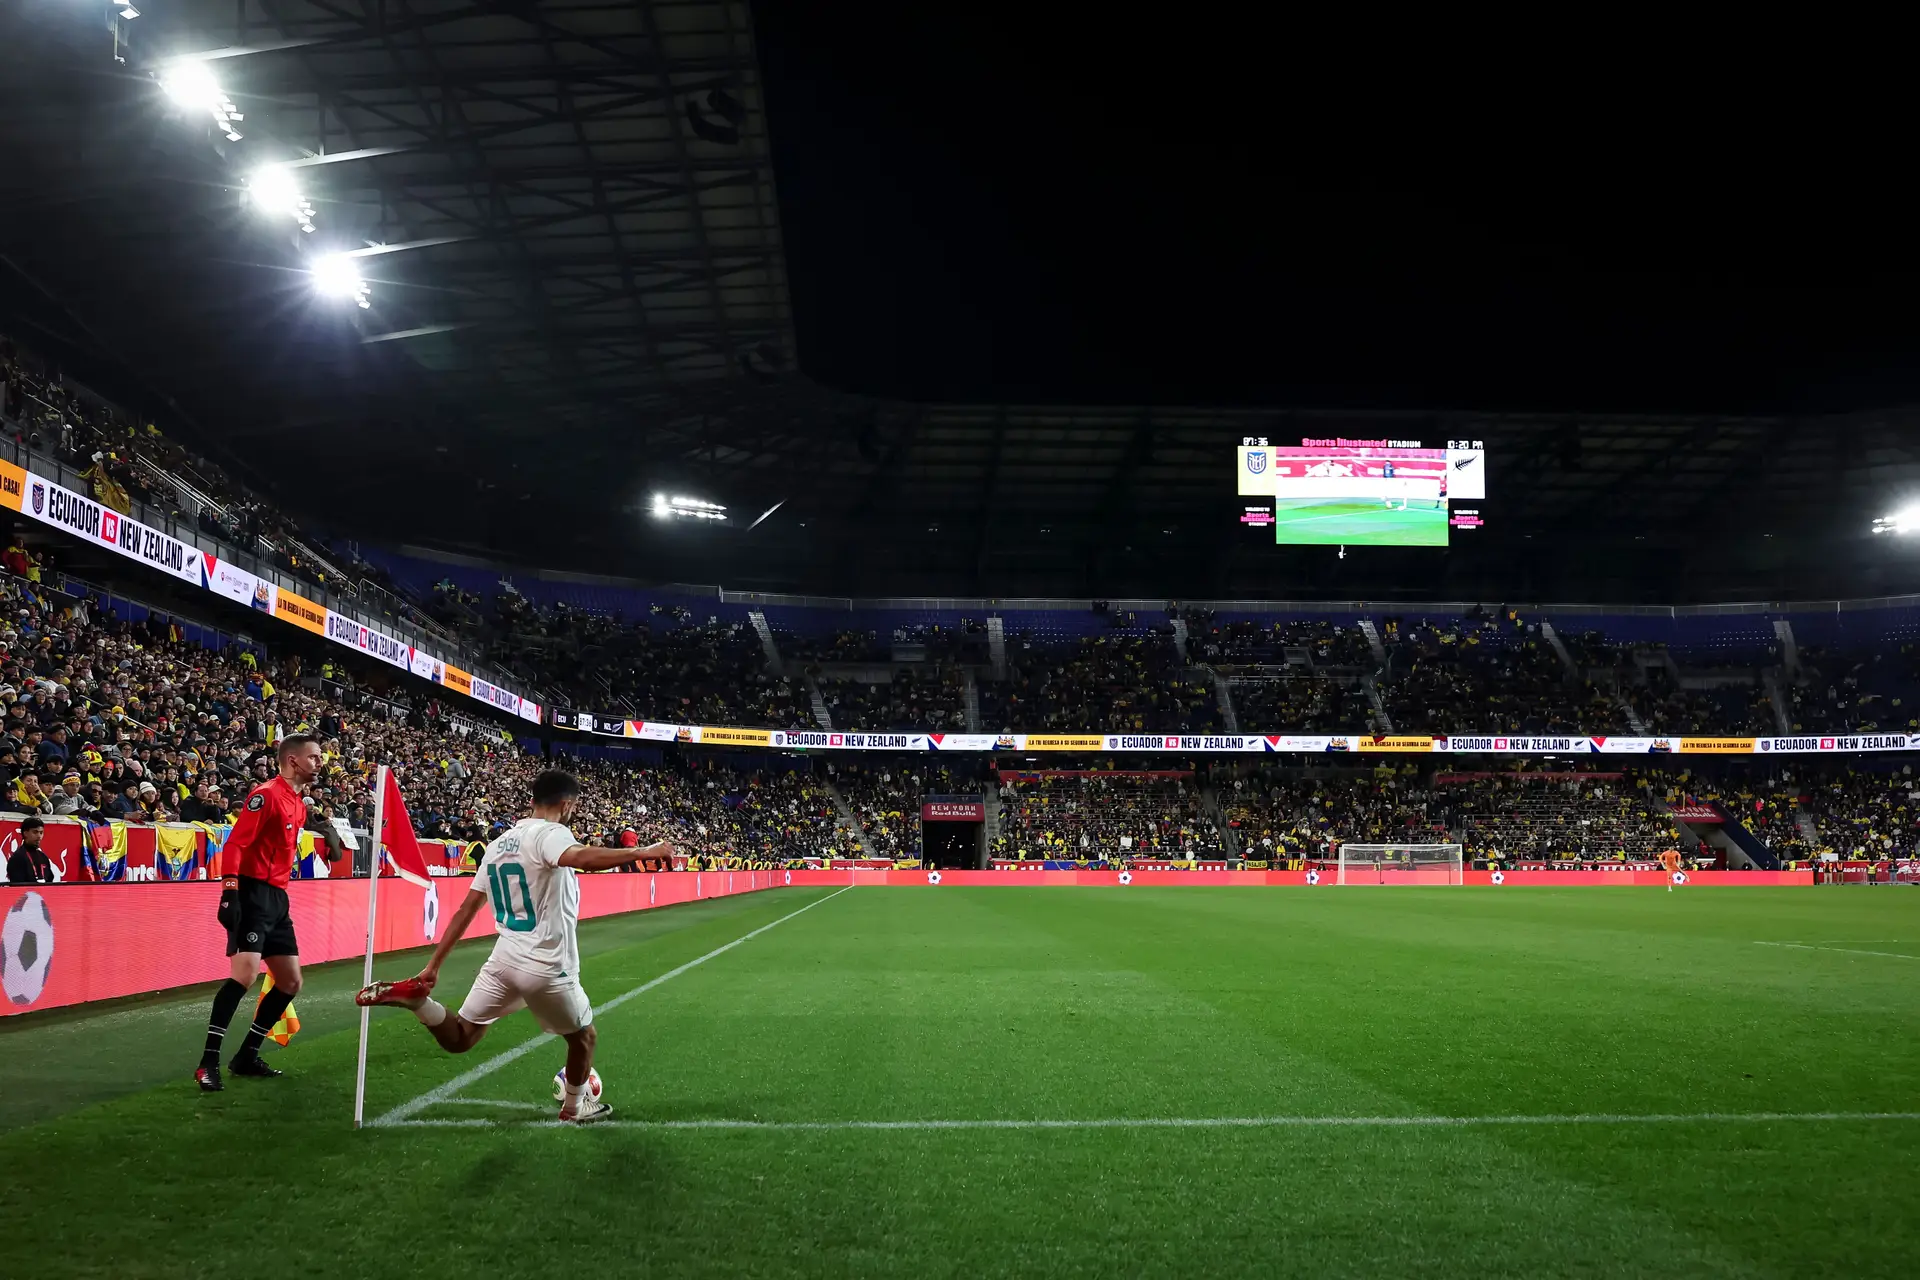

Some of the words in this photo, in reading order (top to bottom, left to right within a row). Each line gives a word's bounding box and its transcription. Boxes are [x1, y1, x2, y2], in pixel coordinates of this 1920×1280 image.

[1302, 438, 1336, 448] Sports
[1337, 438, 1387, 448] Illustrated
[1388, 440, 1422, 448] STADIUM
[49, 486, 100, 537] ECUADOR
[106, 517, 115, 539] VS
[120, 519, 142, 554] NEW
[144, 529, 183, 571] ZEALAND
[336, 616, 359, 646] ECUADOR
[368, 630, 379, 653] NEW
[379, 635, 399, 662] ZEALAND
[557, 714, 567, 724] ECU
[573, 715, 577, 726] 2
[594, 718, 598, 729] 0
[787, 734, 827, 746] ECUADOR
[833, 736, 841, 745] VS
[845, 736, 865, 746] NEW
[868, 736, 906, 748] ZEALAND
[1122, 736, 1162, 748] ECUADOR
[1168, 738, 1177, 748] VS
[1181, 737, 1200, 748] NEW
[1204, 737, 1243, 749] ZEALAND
[1452, 738, 1492, 750] ECUADOR
[1497, 740, 1506, 749] VS
[1510, 738, 1529, 750] NEW
[1532, 738, 1570, 750] ZEALAND
[1774, 739, 1818, 750] ECUADOR
[1824, 739, 1832, 748] VS
[1838, 738, 1858, 750] NEW
[1862, 736, 1906, 748] ZEALAND
[487, 862, 536, 932] 10
